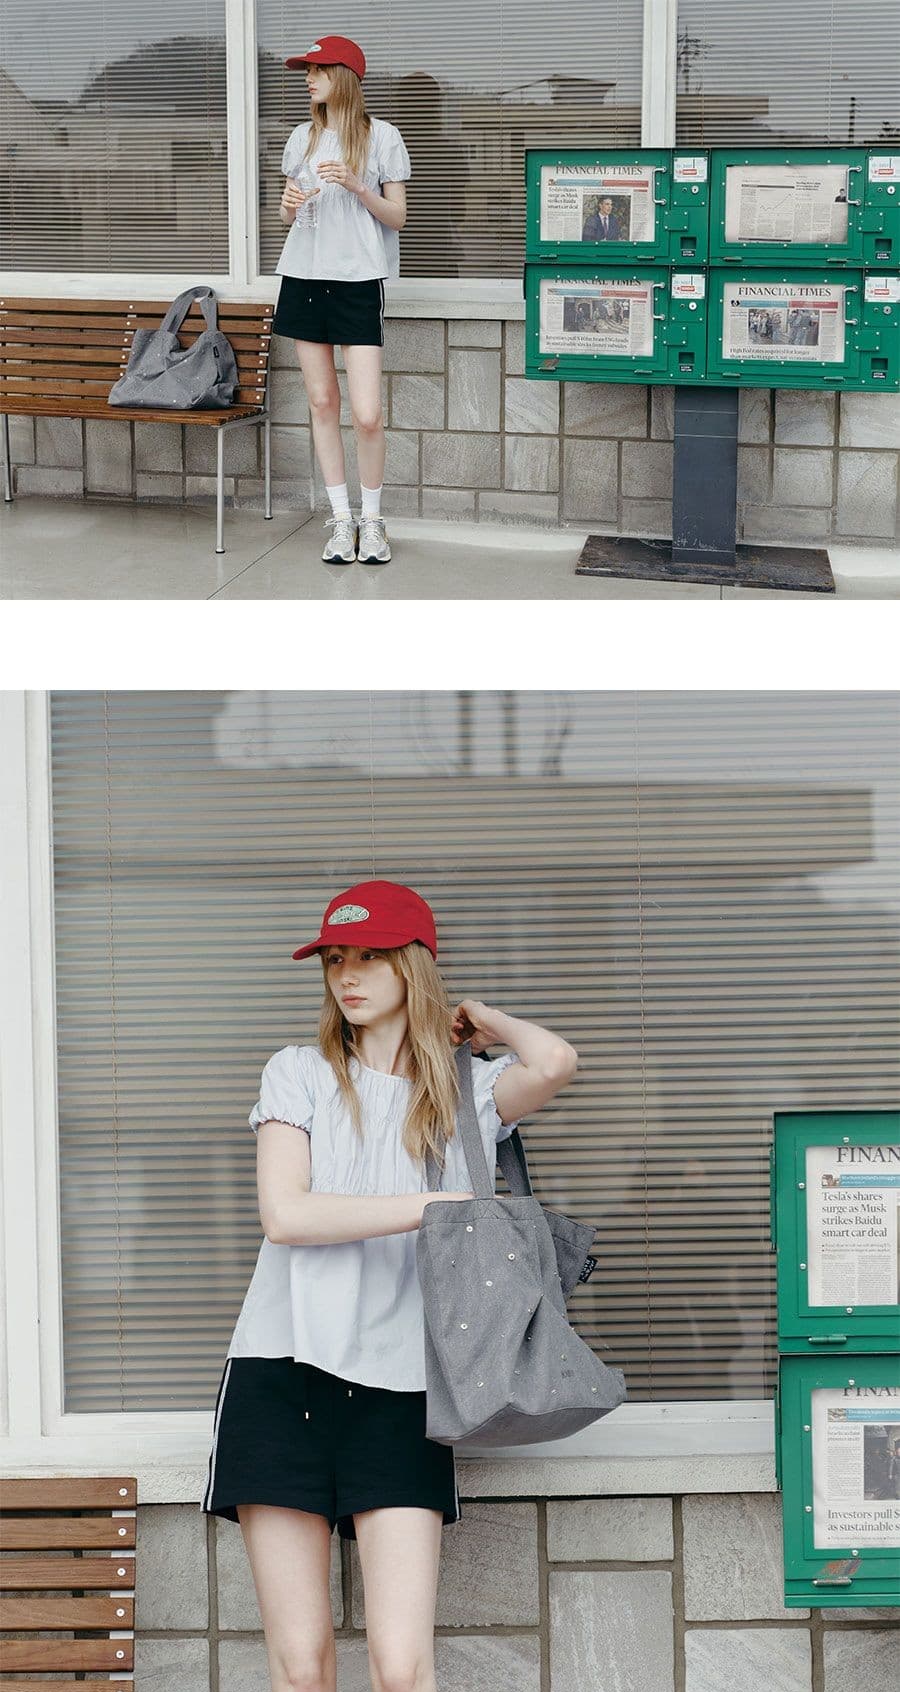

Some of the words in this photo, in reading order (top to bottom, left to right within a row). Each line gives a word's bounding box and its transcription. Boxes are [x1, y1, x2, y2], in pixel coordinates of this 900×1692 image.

[555, 166, 610, 175] FINANCIAL
[612, 167, 643, 175] TIMES
[738, 287, 796, 296] FINANCIAL
[800, 288, 832, 296] TIMES
[822, 1192, 852, 1201] Tesla's
[852, 1191, 883, 1201] shares
[822, 1205, 848, 1214] surge
[849, 1205, 859, 1213] as
[861, 1203, 887, 1213] Musk
[822, 1216, 854, 1225] strikes
[855, 1216, 882, 1225] Baidu
[822, 1229, 849, 1237] smart
[851, 1229, 867, 1237] car
[867, 1228, 887, 1237] deal
[827, 1509, 872, 1519] Investors
[873, 1509, 892, 1521] pull
[839, 1522, 894, 1531] sustainable
